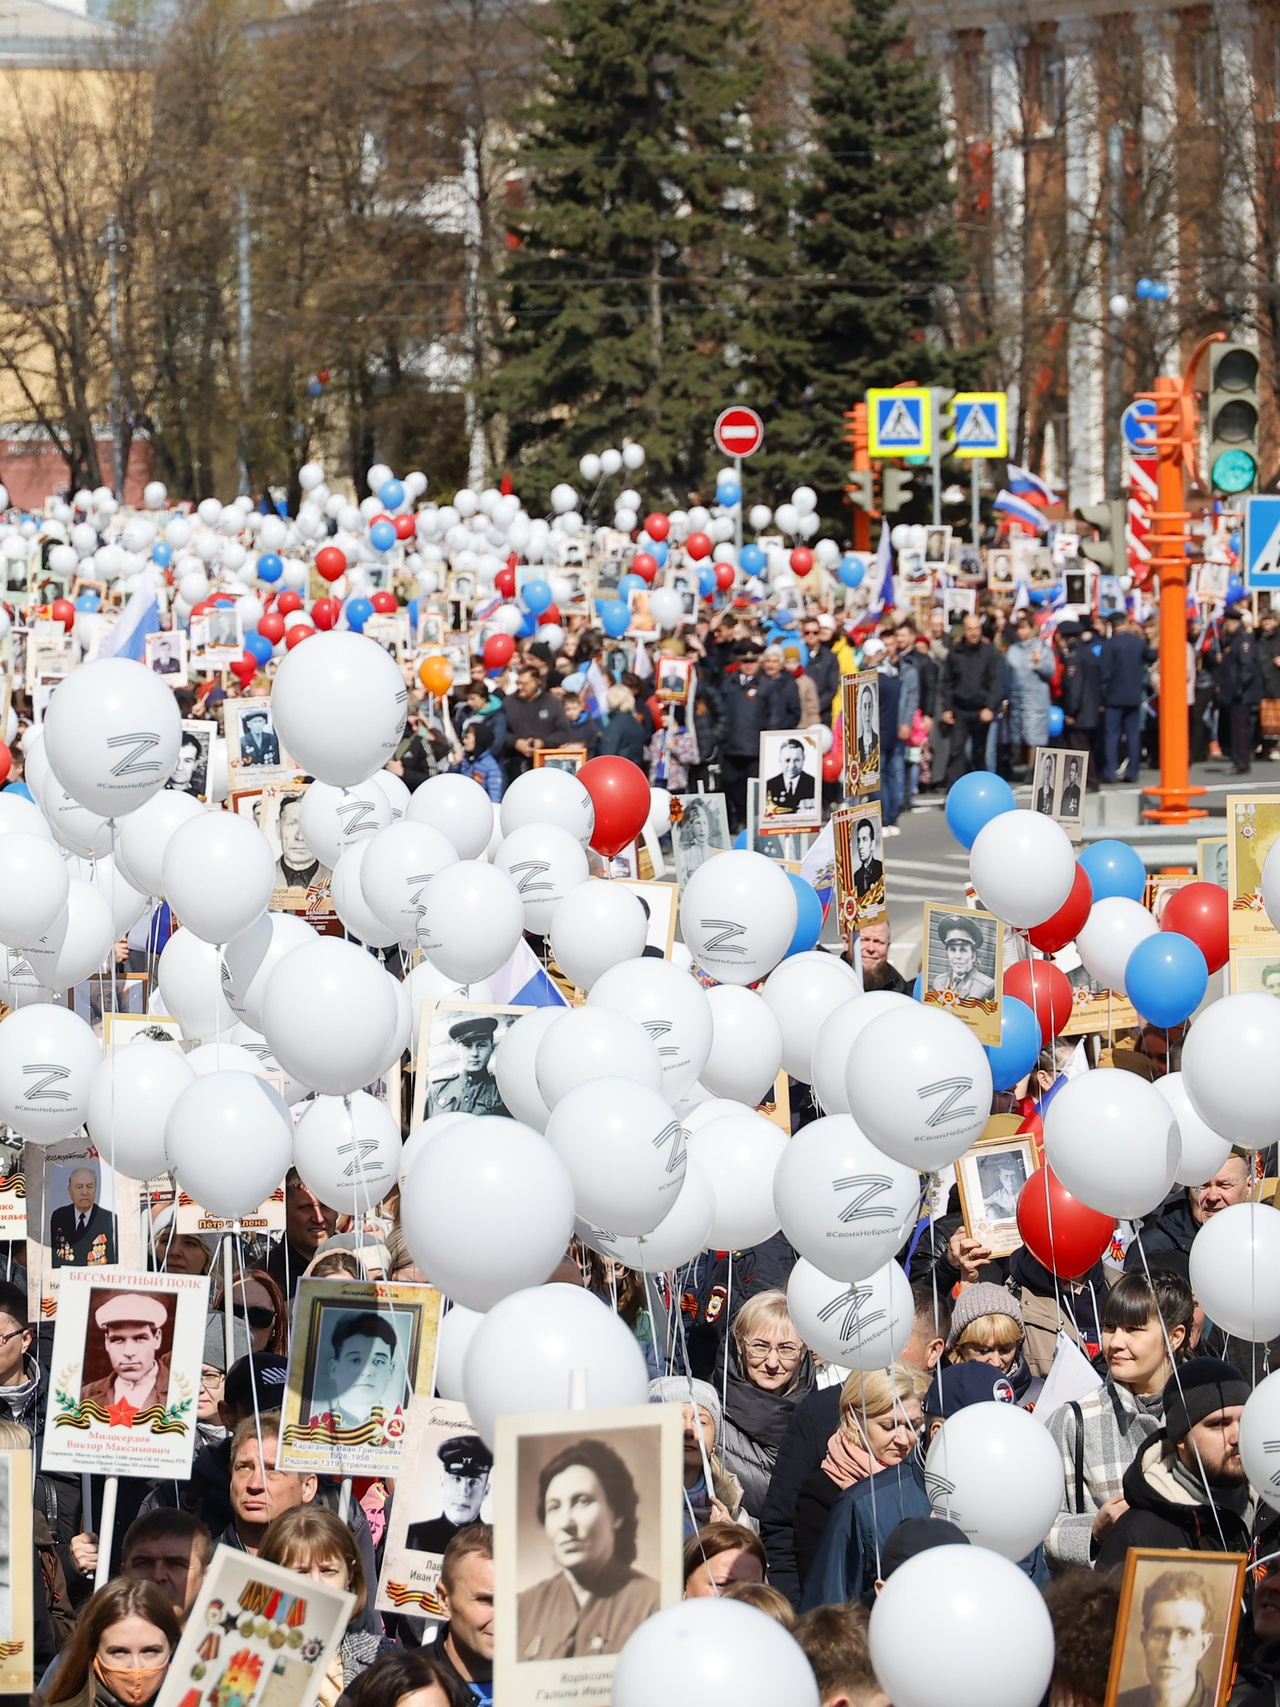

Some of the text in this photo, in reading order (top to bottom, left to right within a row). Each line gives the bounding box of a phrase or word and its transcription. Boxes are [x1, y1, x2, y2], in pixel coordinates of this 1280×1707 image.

[22, 1063, 72, 1101] Z
[916, 1076, 979, 1128] Z
[831, 1173, 899, 1224] Z
[198, 1219, 224, 1230] Пётр
[69, 1271, 203, 1289] БЕССМЕРТНЫЙ ПОЛК
[88, 1430, 151, 1443] Милосердов
[66, 1439, 171, 1455] Виктор Максимович
[292, 1441, 357, 1453] Караганов Иван
[284, 1457, 318, 1467] Рядовой
[409, 1569, 432, 1582] Иван
